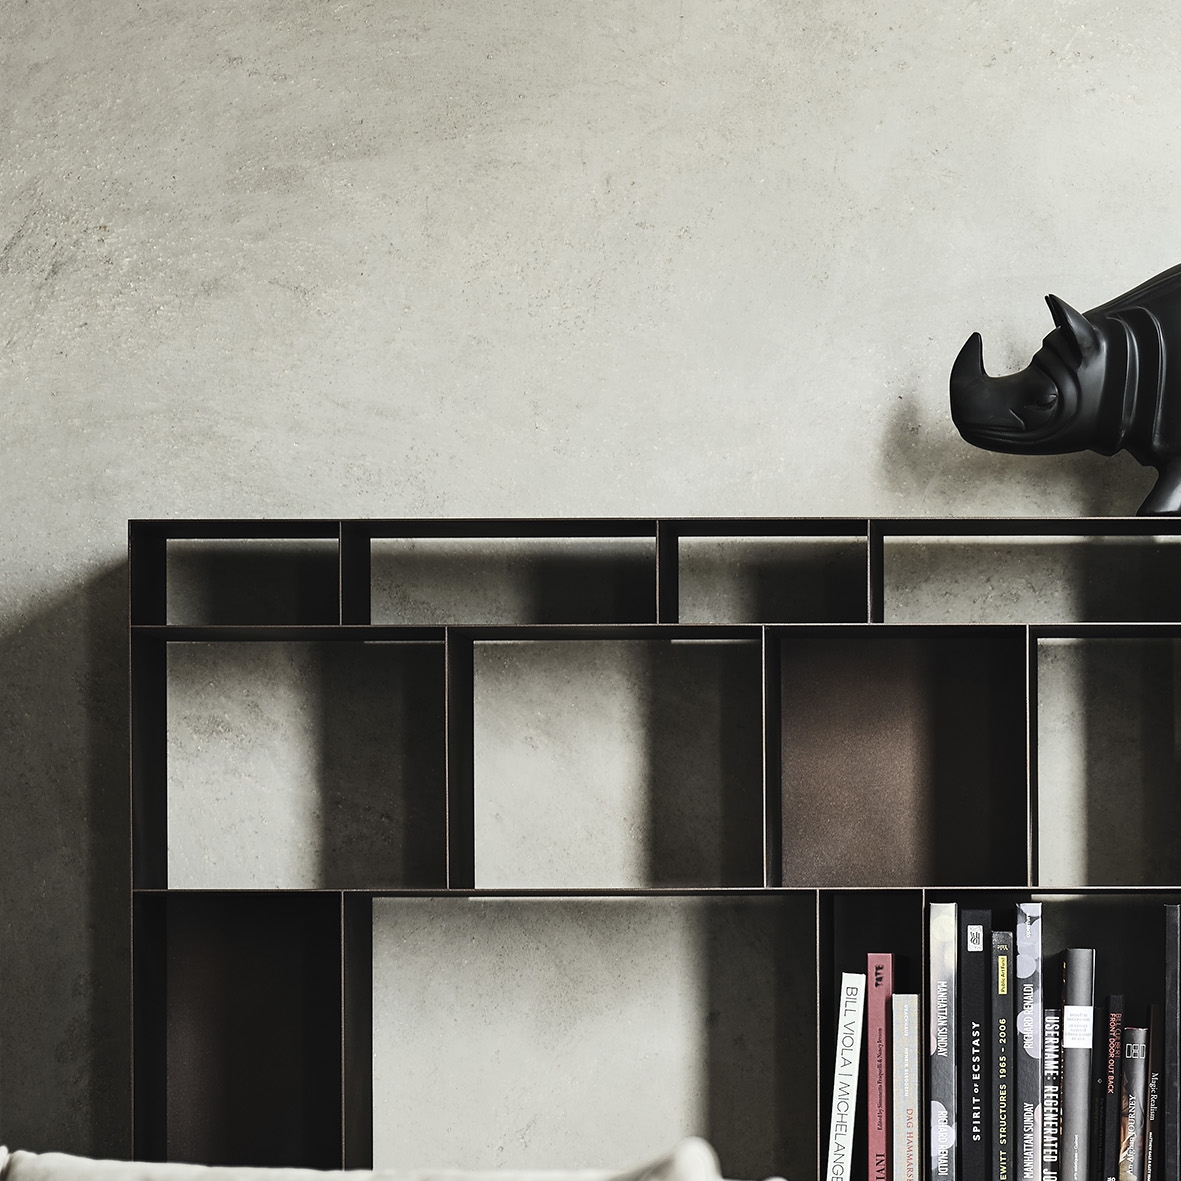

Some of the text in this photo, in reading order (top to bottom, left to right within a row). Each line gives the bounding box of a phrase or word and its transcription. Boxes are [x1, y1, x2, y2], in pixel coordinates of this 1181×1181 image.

[875, 964, 884, 988] TATE
[844, 986, 859, 1017] BILL
[937, 981, 947, 1057] MANHATTAN SUNDAY
[1023, 984, 1034, 1049] RICHARD RENALDI
[1109, 1013, 1117, 1037] FRONT
[840, 1021, 856, 1068] VIOLA
[972, 1021, 980, 1081] ECSTASY
[999, 1018, 1007, 1044] 2006
[999, 1056, 1007, 1078] 1965
[1107, 1075, 1115, 1094] BACK
[973, 1096, 981, 1141] SPIRIT
[999, 1084, 1007, 1145] STRUCTURES
[1150, 1072, 1159, 1121] Magic Realism
[937, 1111, 948, 1176] RICHARD RENALDI
[1023, 1102, 1034, 1179] MANHATTAN SUNDAY
[1043, 1086, 1059, 1163] REGENERATED
